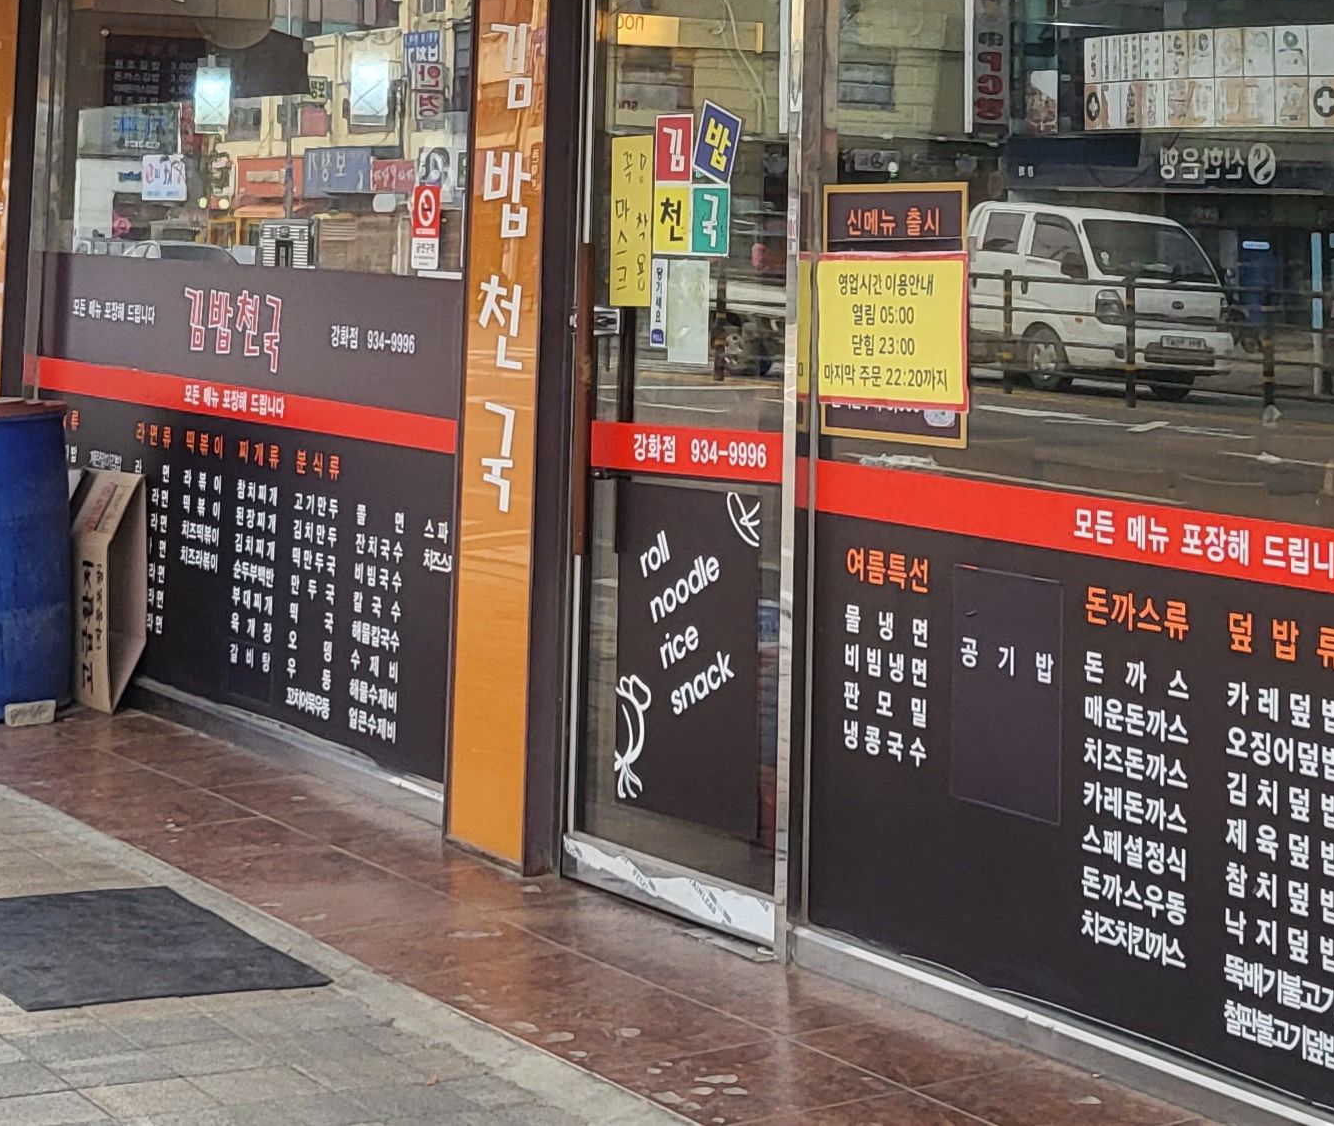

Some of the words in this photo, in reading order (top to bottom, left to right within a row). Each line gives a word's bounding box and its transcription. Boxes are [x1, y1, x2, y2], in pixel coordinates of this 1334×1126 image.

[846, 208, 896, 236] 신메뉴
[905, 207, 940, 237] 출시
[479, 22, 532, 513] 김밥천국
[838, 273, 883, 296] 영업시간
[884, 273, 934, 296] 이용안내
[72, 299, 87, 317] 모든
[88, 301, 102, 319] 메뉴
[104, 302, 125, 322] 포장해
[127, 304, 155, 325] 드립니다
[851, 304, 876, 328] 열림
[879, 305, 915, 326] 05:00
[185, 286, 282, 373] 김밥천국
[331, 325, 359, 350] 강화점
[367, 330, 415, 354] 934-9996
[851, 335, 875, 357] 닫힘
[878, 336, 916, 356] 23:00
[824, 364, 855, 385] 마지막
[859, 365, 882, 387] 주문
[885, 368, 948, 392] 22:20까지
[184, 384, 200, 405] 모든
[204, 386, 220, 407] 메뉴
[222, 389, 247, 413] 포장해
[250, 392, 285, 418] 드립니다
[135, 422, 172, 448] 라면류
[186, 430, 223, 459] 떡볶이
[239, 440, 280, 469] 찌개류
[296, 449, 340, 481] 분식류
[633, 433, 676, 464] 강화점
[690, 438, 767, 468] 934-9996
[183, 469, 222, 495] 라볶이
[237, 479, 278, 507] 참치찌개
[182, 495, 221, 521] 떡볶이
[235, 506, 277, 534] 된장찌개
[294, 492, 338, 520] 고기만두
[181, 520, 220, 547] 치즈떡볶이
[234, 533, 275, 562] 김치찌개
[293, 519, 337, 548] 김치만두
[355, 534, 403, 564] 잔치국수
[1073, 507, 1116, 548] 모든
[1126, 515, 1171, 555] 메뉴
[1181, 520, 1251, 569] 포장해
[180, 546, 218, 573] 치즈라볶이
[292, 547, 336, 577] 떡만두국
[639, 530, 671, 578] roll
[846, 546, 929, 594] 여름특선
[233, 559, 274, 589] 순두부백반
[354, 562, 402, 594] 비빔국수
[649, 554, 720, 624] noodle
[232, 586, 273, 616] 부대찌개
[1084, 585, 1191, 641] 돈까스류
[352, 621, 399, 654] 해물칼국수
[659, 625, 700, 669] rice
[669, 650, 735, 715] snack
[844, 643, 928, 689] 비빔냉면
[285, 687, 330, 720] 꼬치어묵우동
[349, 678, 397, 713] 해물수제비
[348, 707, 396, 744] 얼큰수제비
[1083, 694, 1190, 745] 매운돈까스
[843, 719, 927, 768] 냉콩국수
[1083, 736, 1189, 791] 치즈돈까스
[1082, 780, 1188, 835] 카레돈까스
[1080, 823, 1187, 883] 스페셜정식
[1080, 866, 1187, 927] 돈까스우동
[1080, 908, 1187, 970] 치즈치킨까스
